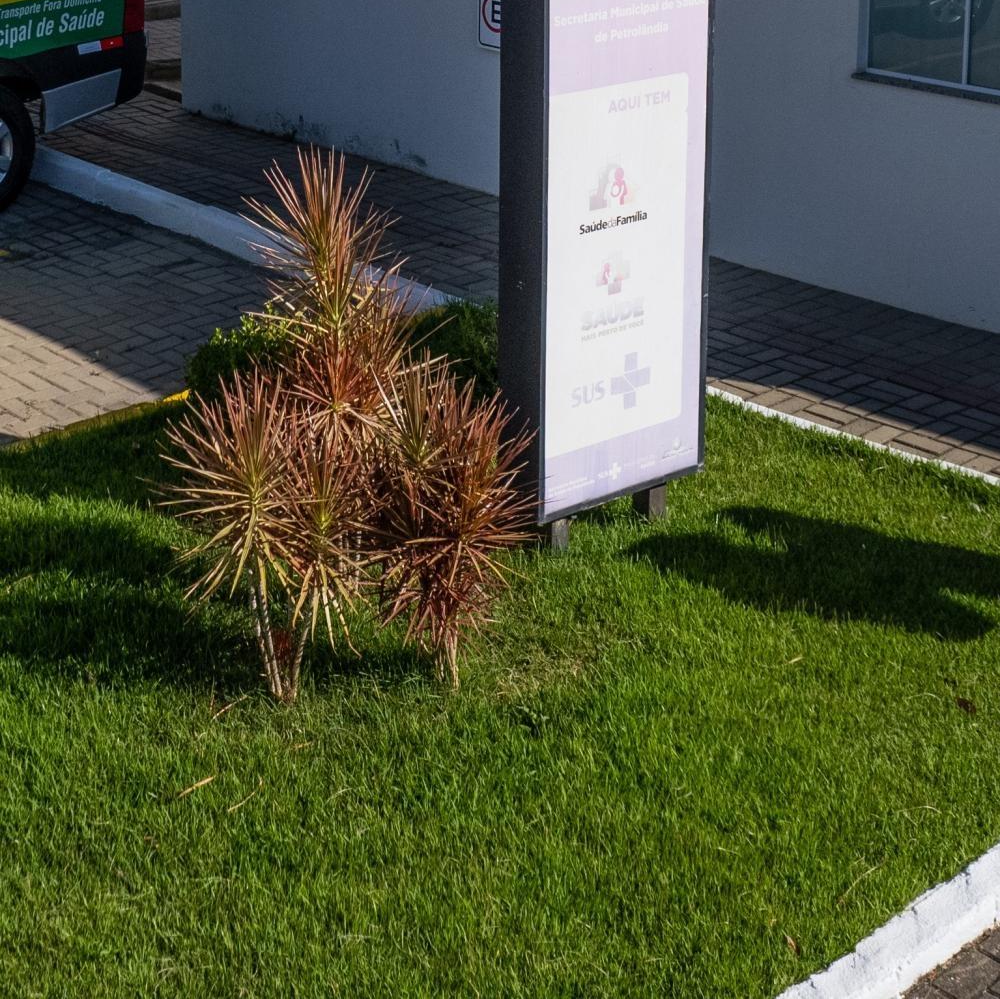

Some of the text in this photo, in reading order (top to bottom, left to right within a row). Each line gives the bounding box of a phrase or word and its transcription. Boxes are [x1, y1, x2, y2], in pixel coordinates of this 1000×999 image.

[43, 0, 61, 12] Fora
[553, 10, 607, 27] Secretaria
[610, 0, 659, 19] Municipal
[661, 0, 674, 10] de
[36, 17, 54, 37] de
[59, 8, 105, 33] Saúde
[594, 31, 607, 43] de
[608, 90, 671, 113] AQUI TEM
[571, 379, 605, 409] SUS
